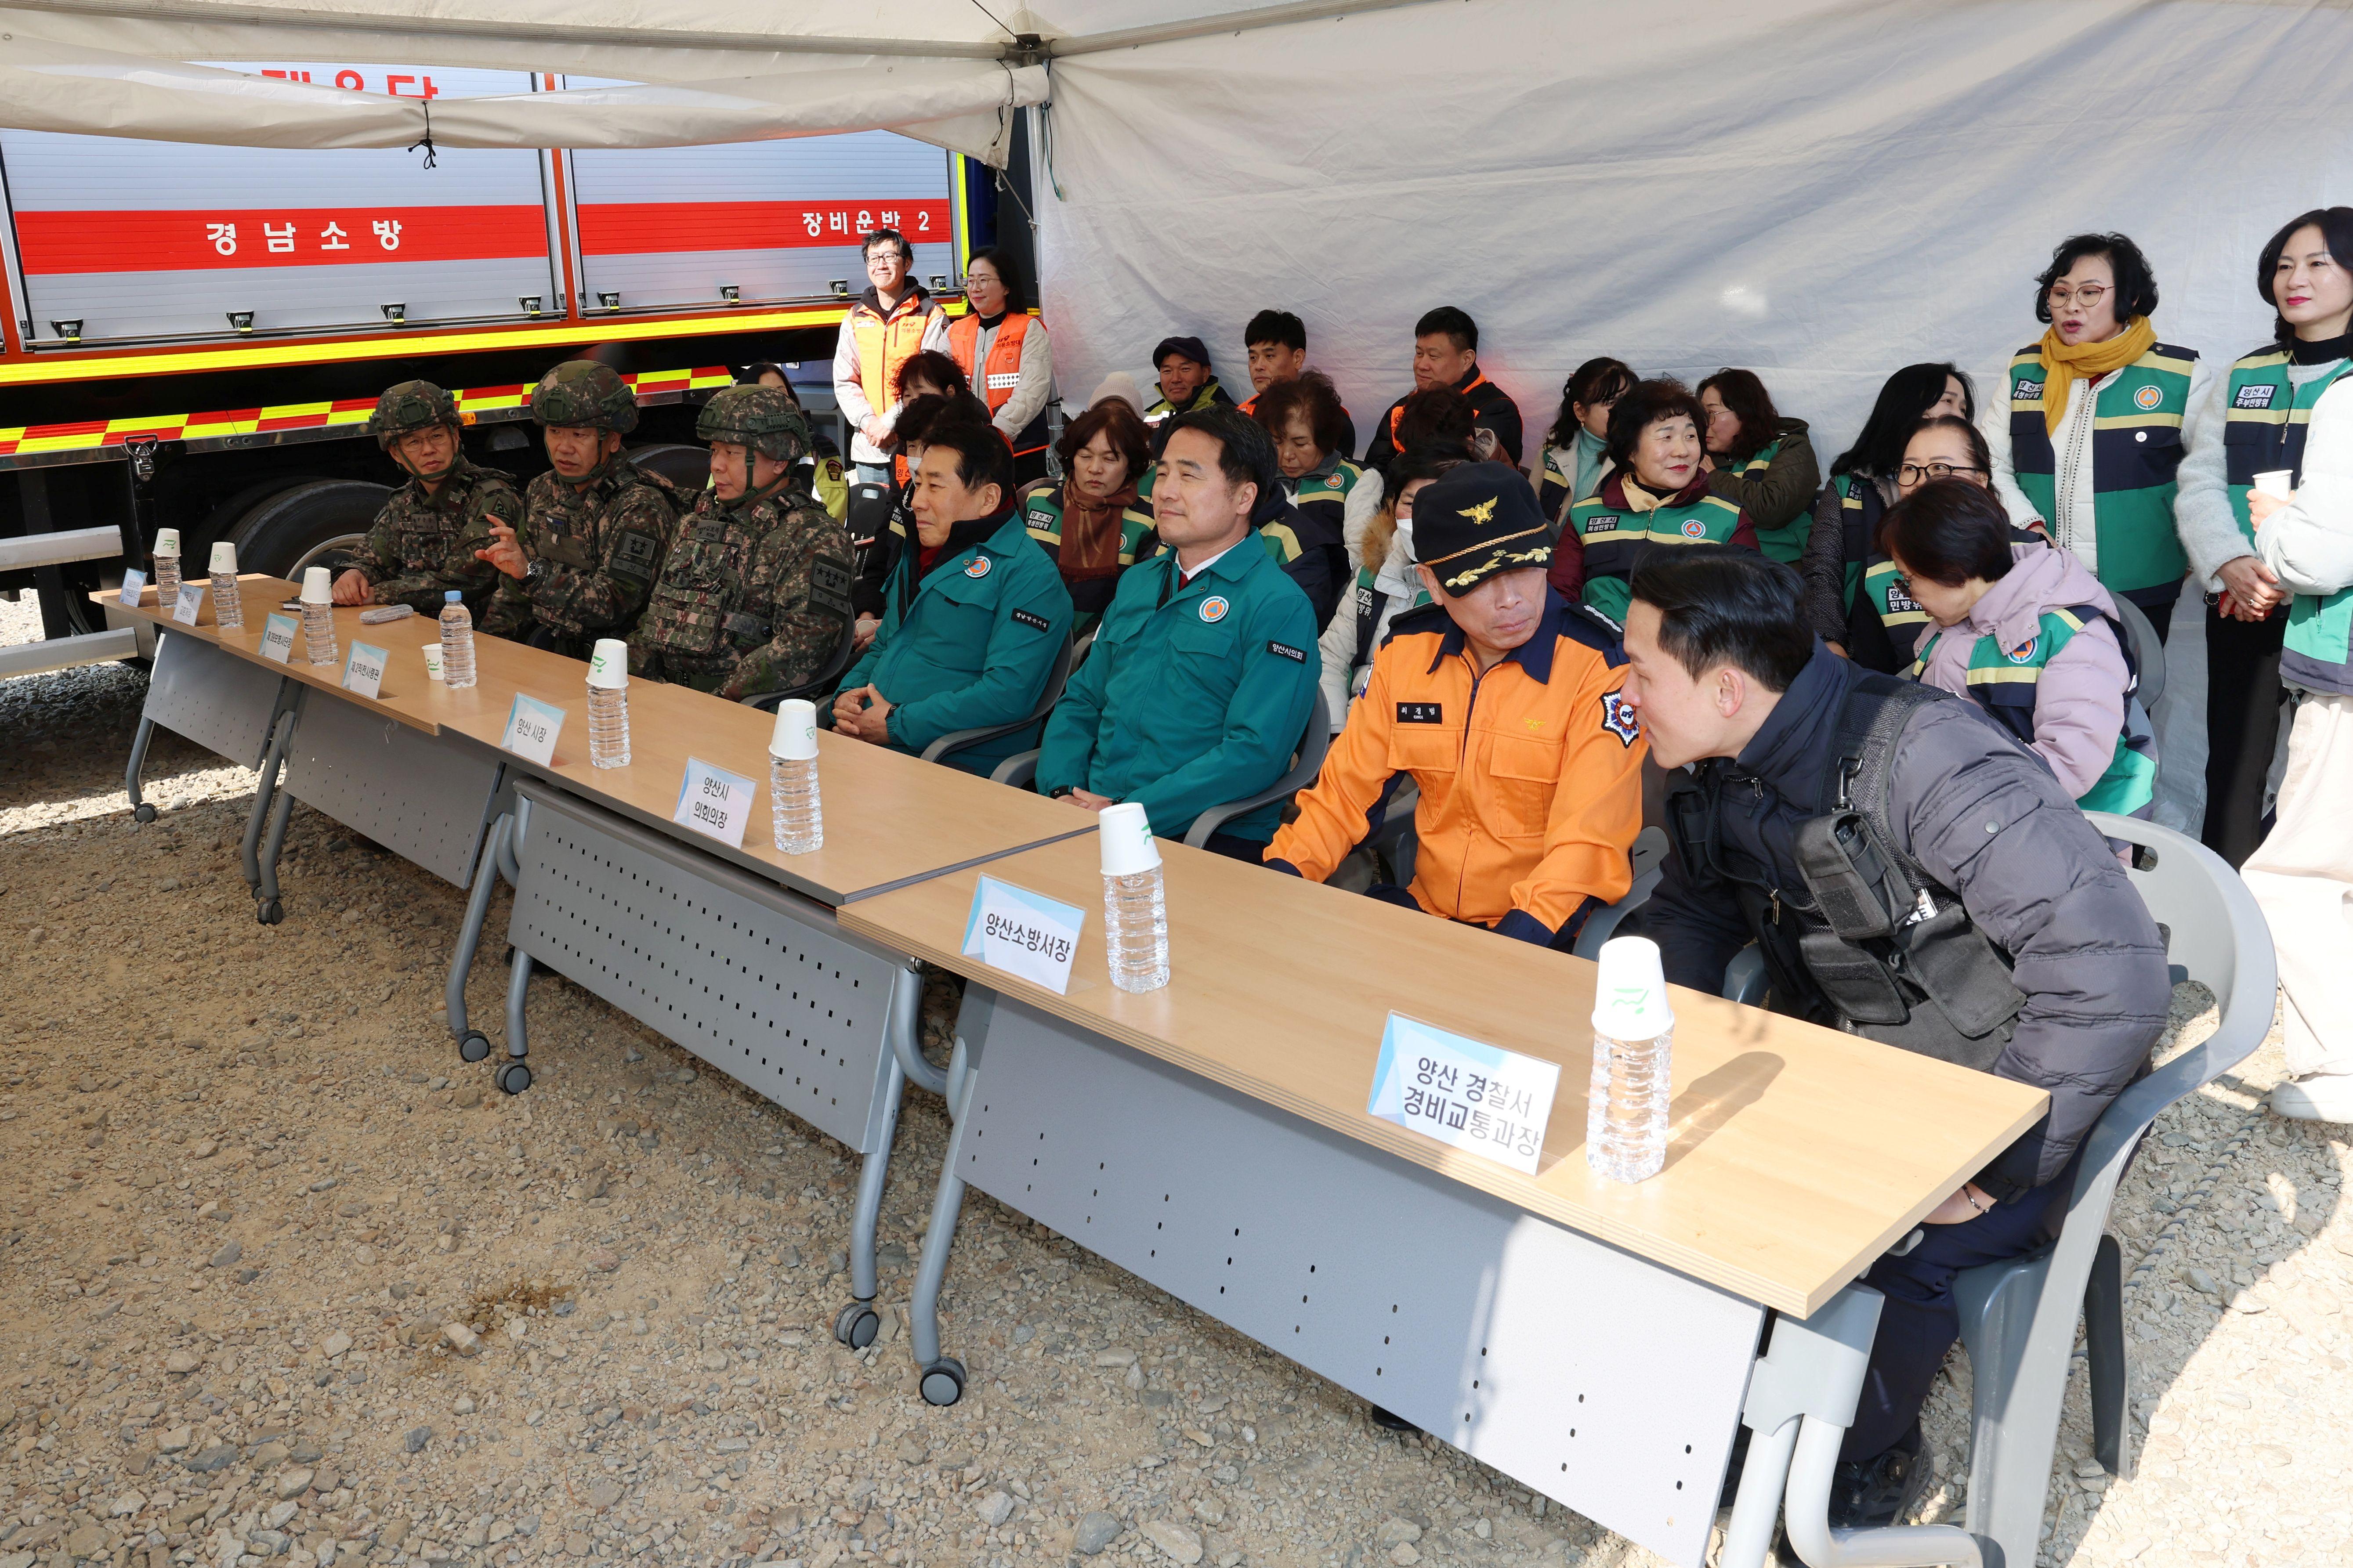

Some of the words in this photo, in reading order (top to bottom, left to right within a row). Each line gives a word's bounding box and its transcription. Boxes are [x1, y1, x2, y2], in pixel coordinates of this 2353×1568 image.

[802, 210, 900, 237] 장비운반
[918, 211, 929, 231] 2
[996, 340, 1021, 348] 의용소방대
[2020, 382, 2044, 391] 양산시
[2243, 388, 2270, 397] 양산시
[2236, 397, 2269, 408] 주부민방위
[1031, 512, 1052, 522] 양산시
[1358, 590, 1372, 603] 양산
[1358, 603, 1372, 616] 방위
[1272, 643, 1303, 660] 양산시의회
[517, 719, 531, 737] 양산
[531, 725, 547, 743] 시장
[703, 777, 729, 801] 양산시
[693, 802, 728, 829] 의회의장
[986, 913, 1070, 962] 양산소방서장
[1417, 1057, 1458, 1093] 양산
[1466, 1073, 1532, 1119] 경찰서
[1404, 1086, 1540, 1156] 경비교통과장
